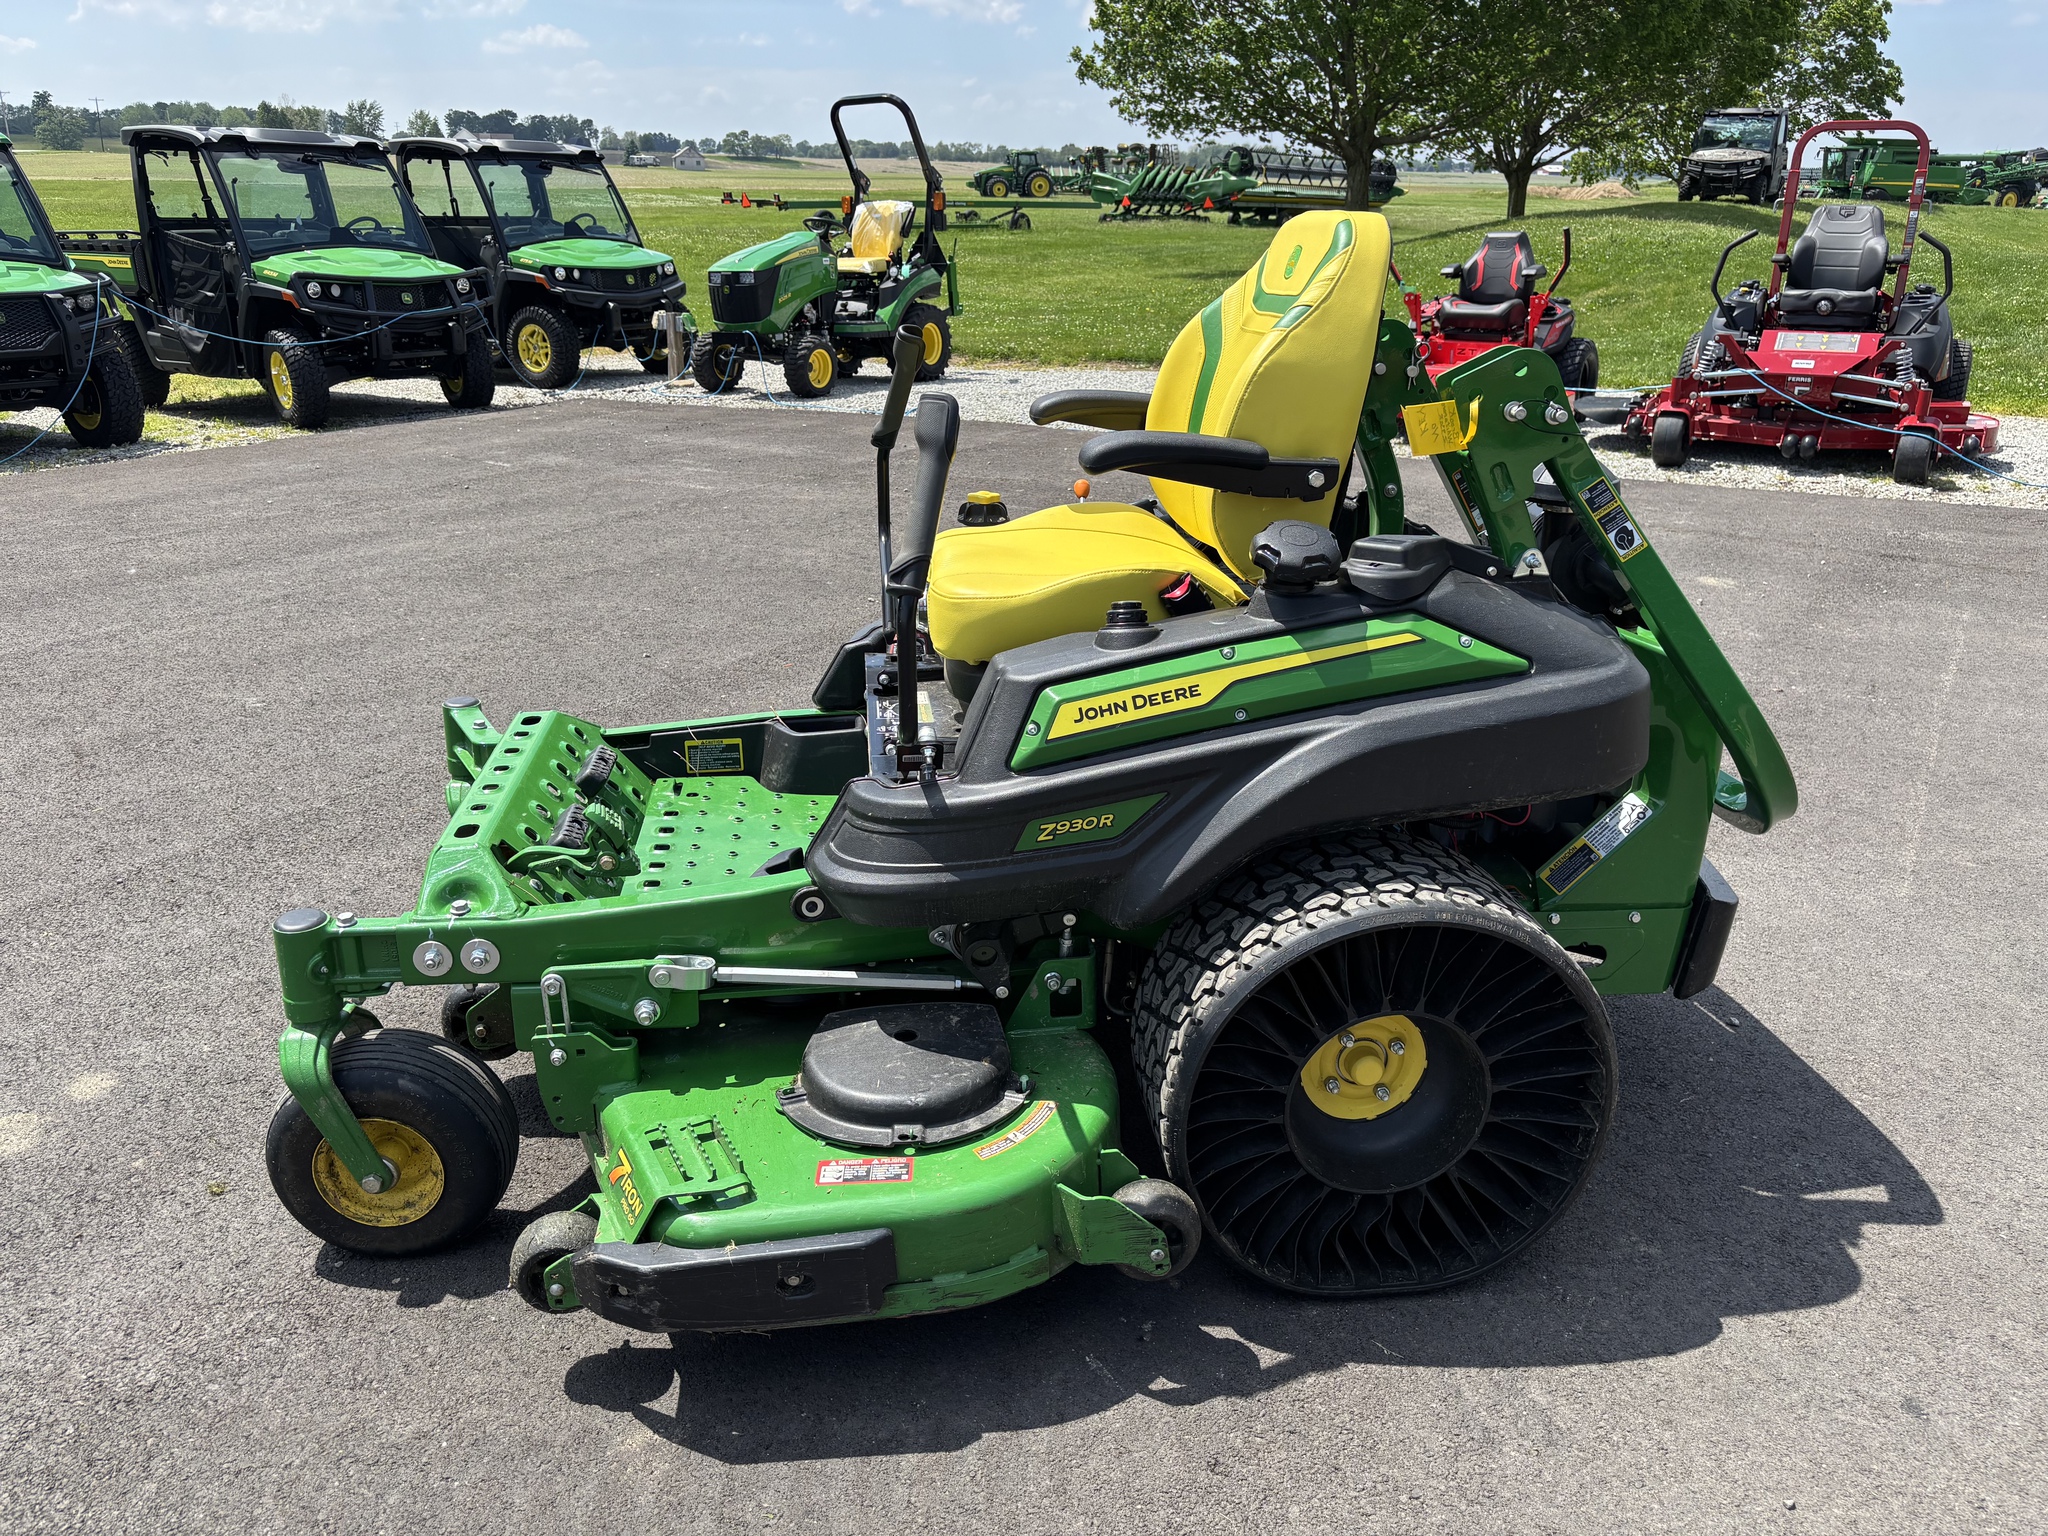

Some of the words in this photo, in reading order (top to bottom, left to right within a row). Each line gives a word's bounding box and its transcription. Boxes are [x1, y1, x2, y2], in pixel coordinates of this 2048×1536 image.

[1073, 700, 1128, 724] JOHN
[1131, 684, 1202, 711] DEERE
[1036, 813, 1114, 842] Z930R
[1552, 845, 1578, 869] ATENCIÓN
[1434, 910, 1452, 920] NOT
[1454, 911, 1474, 923] FOR
[1475, 916, 1514, 935] HIGHWAY
[1515, 929, 1532, 944] USE
[620, 1173, 644, 1218] IRON
